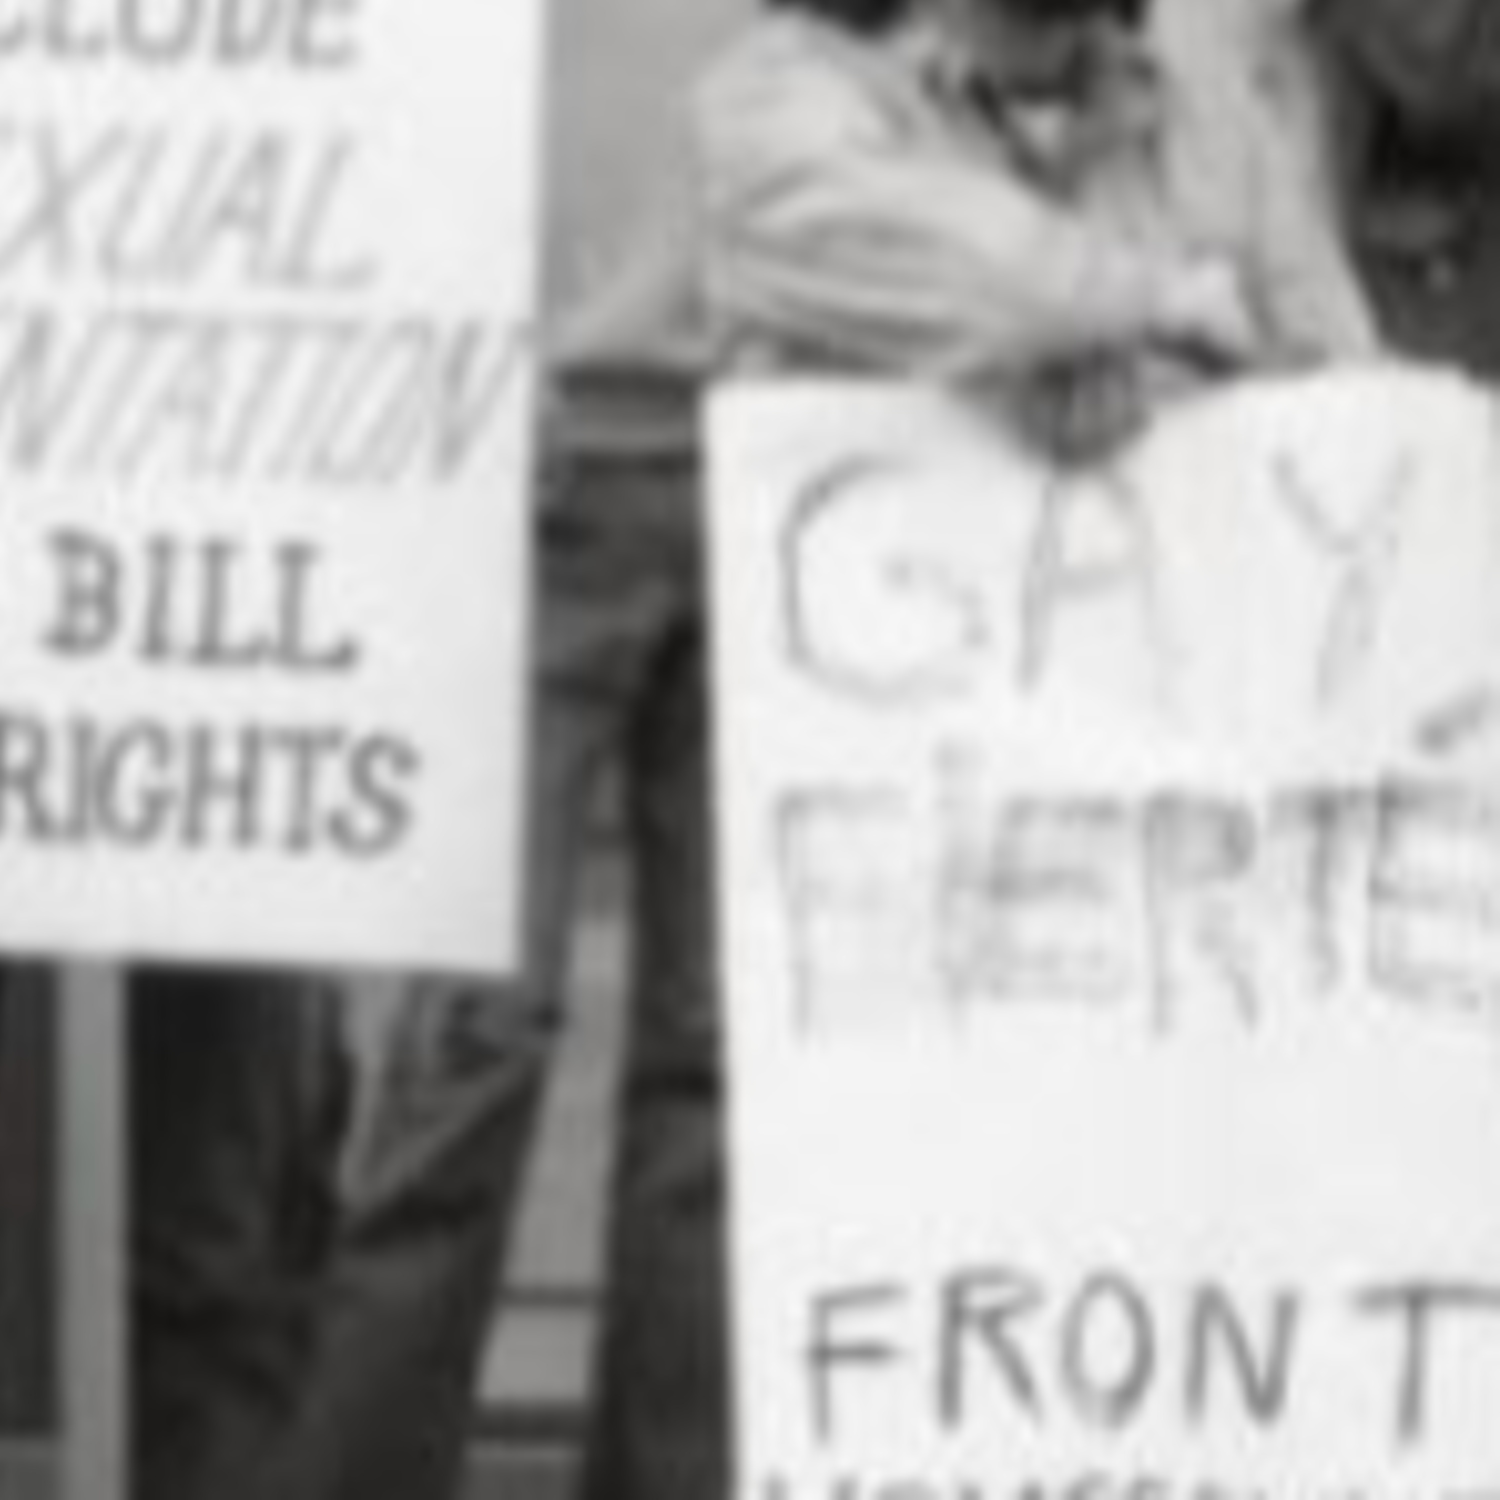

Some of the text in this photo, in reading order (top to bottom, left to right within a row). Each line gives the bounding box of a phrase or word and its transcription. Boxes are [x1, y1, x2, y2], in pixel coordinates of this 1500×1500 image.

[38, 528, 358, 670] BILL
[778, 450, 1418, 715] GAY
[804, 1268, 1500, 1445] FRONT
